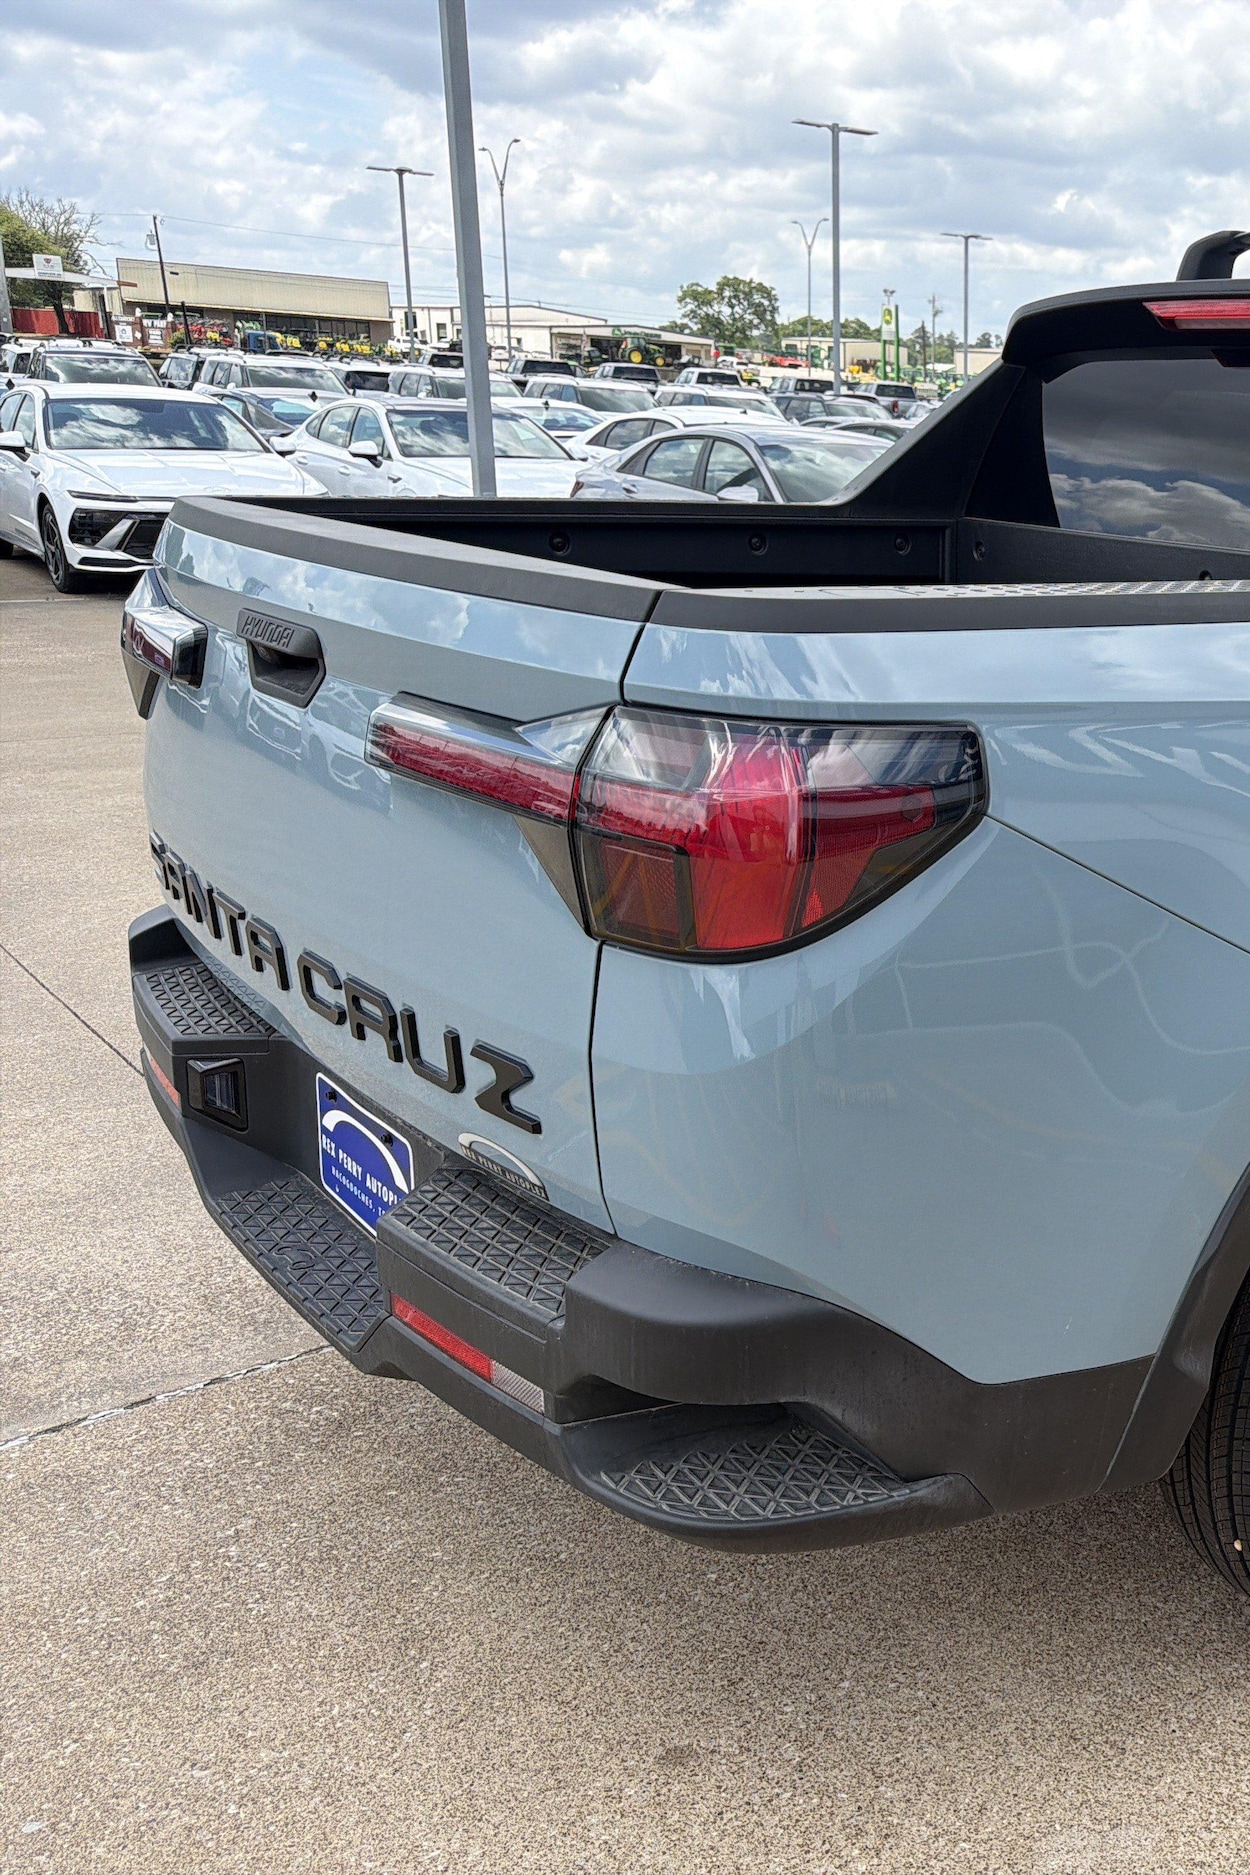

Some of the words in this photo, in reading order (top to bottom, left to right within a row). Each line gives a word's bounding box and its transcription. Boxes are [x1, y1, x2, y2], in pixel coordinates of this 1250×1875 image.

[241, 615, 295, 649] HYUNDAI
[149, 828, 292, 991] SANTA
[297, 948, 542, 1135] CRUZ
[321, 1134, 336, 1158] REX
[338, 1148, 362, 1181] PERRY
